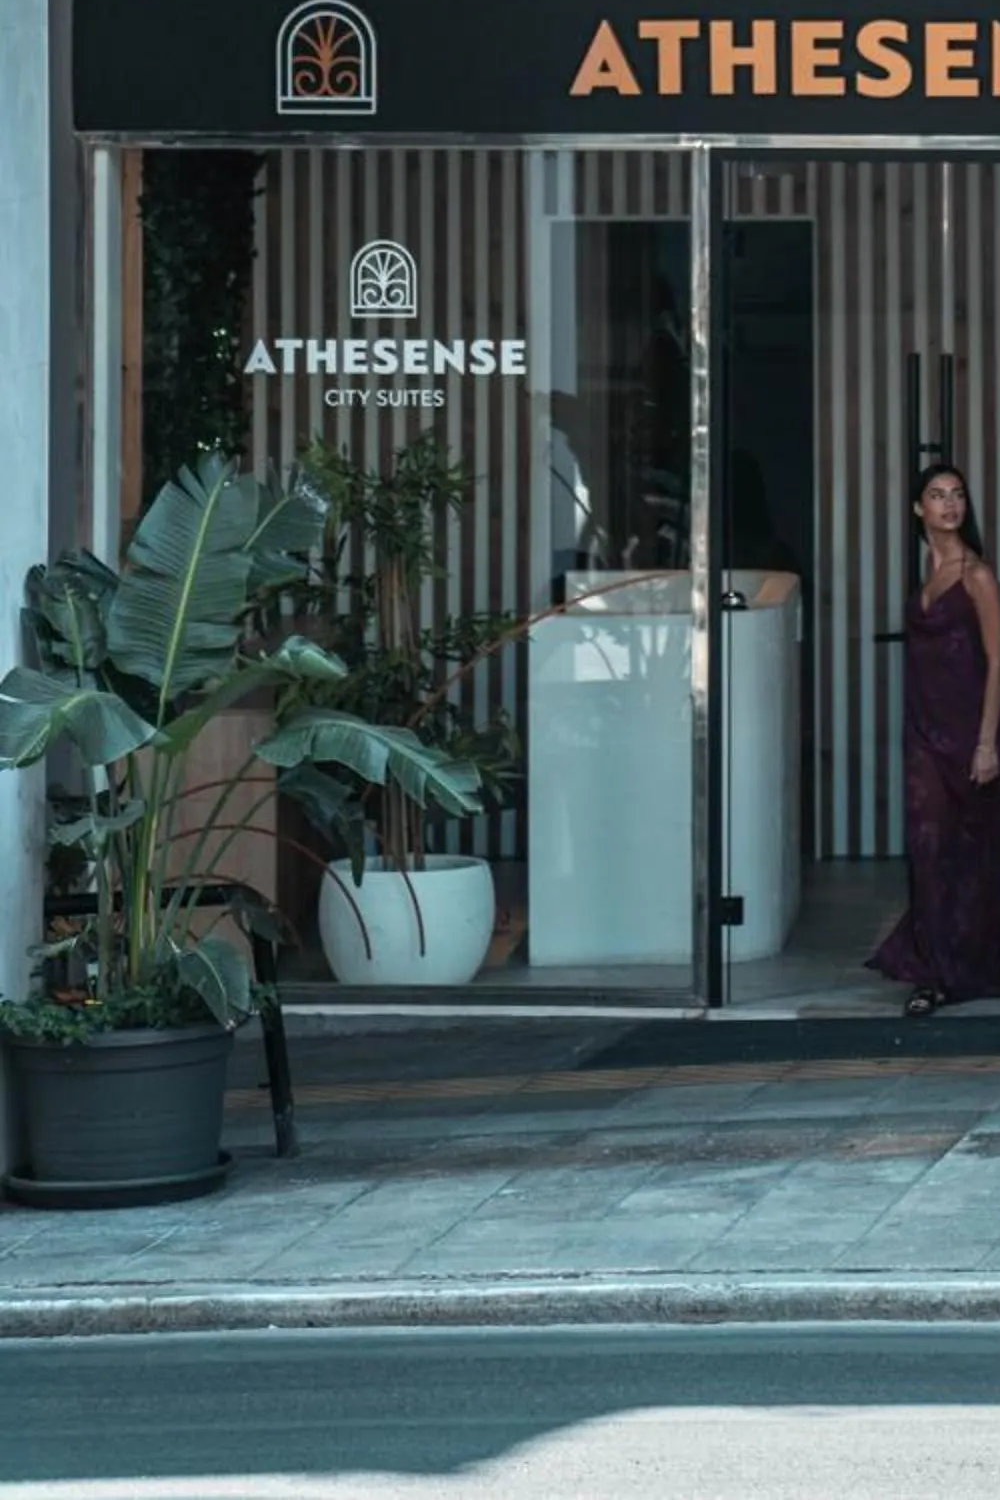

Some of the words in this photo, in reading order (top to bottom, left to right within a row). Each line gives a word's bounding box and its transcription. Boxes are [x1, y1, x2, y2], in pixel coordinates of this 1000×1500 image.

[243, 338, 528, 376] ATHESENSE
[324, 388, 371, 408] CITY
[375, 388, 446, 408] SUITES
